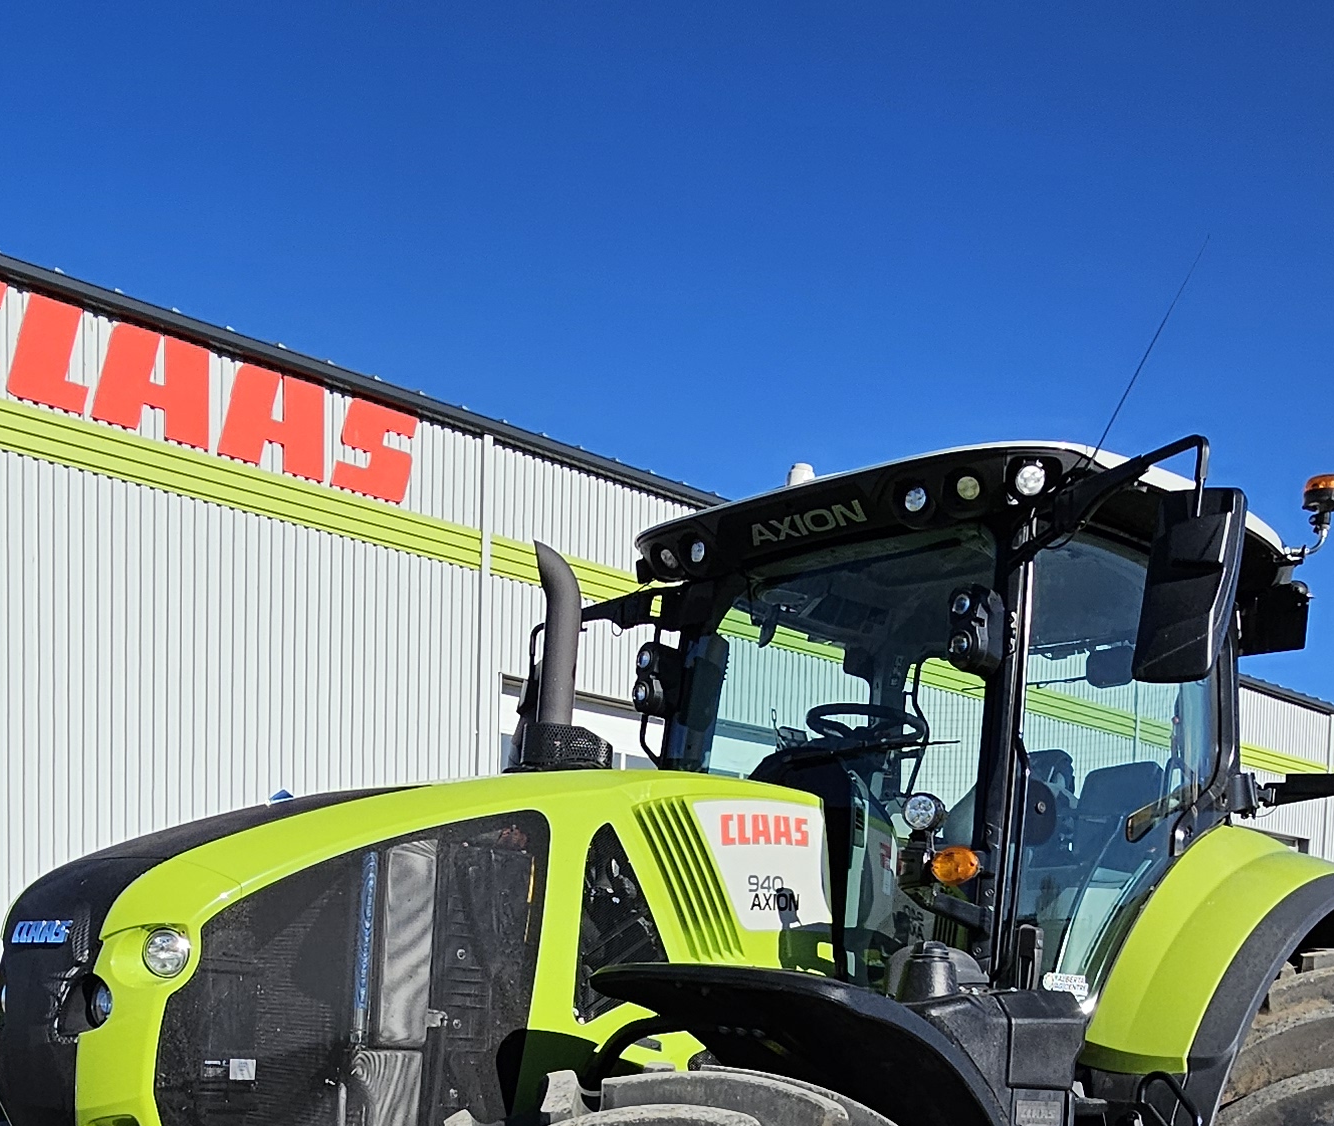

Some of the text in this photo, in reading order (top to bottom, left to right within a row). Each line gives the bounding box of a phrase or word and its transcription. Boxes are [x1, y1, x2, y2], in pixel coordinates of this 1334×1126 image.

[751, 499, 868, 547] AXION
[720, 814, 809, 847] CLAAS
[748, 875, 784, 892] 940
[750, 893, 800, 911] AXION
[11, 919, 73, 943] CLAAS
